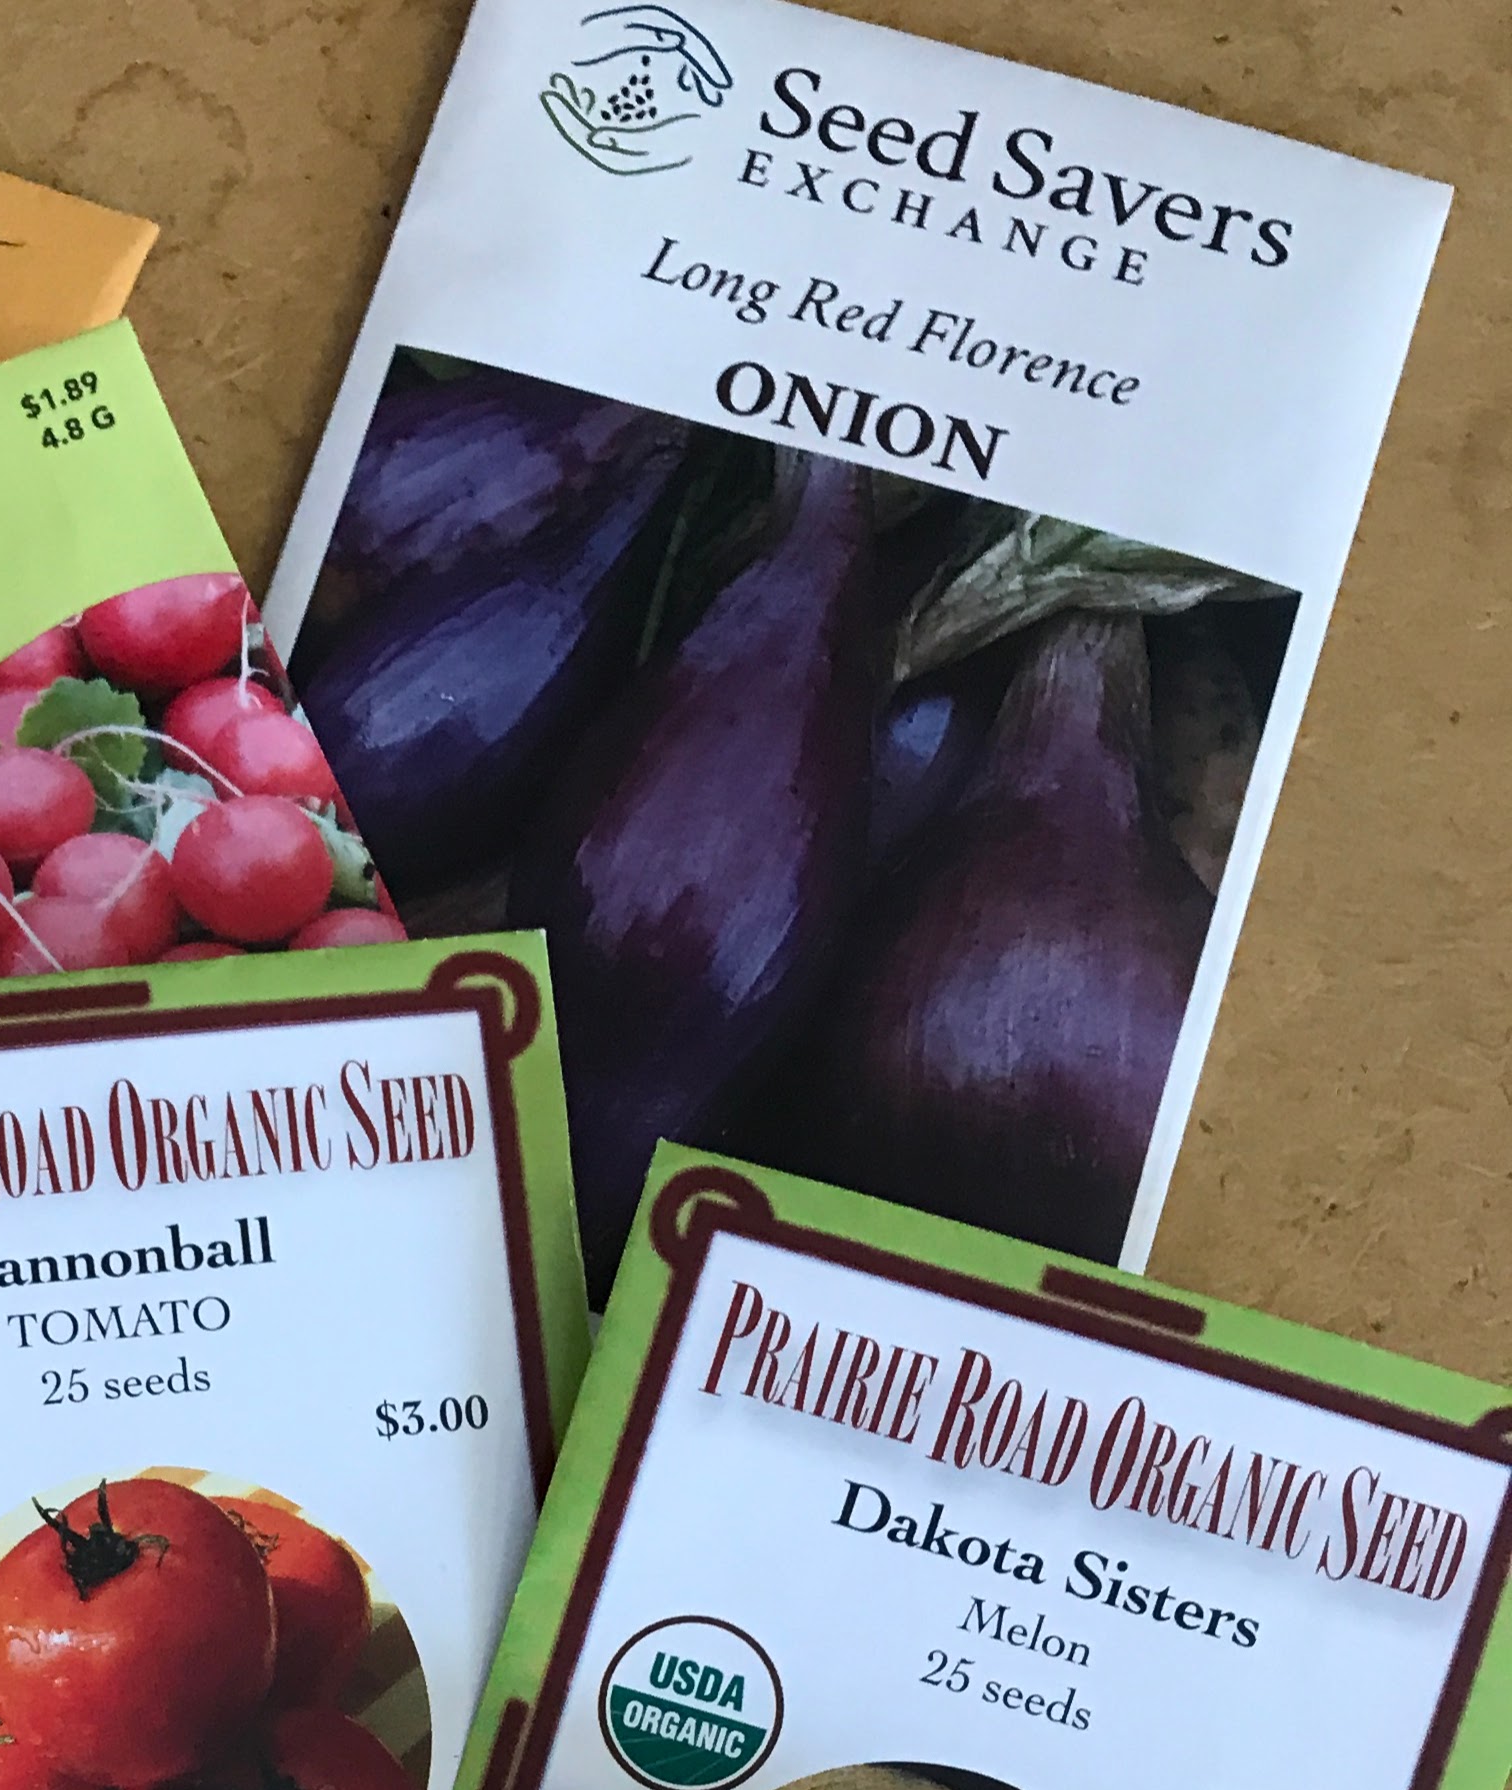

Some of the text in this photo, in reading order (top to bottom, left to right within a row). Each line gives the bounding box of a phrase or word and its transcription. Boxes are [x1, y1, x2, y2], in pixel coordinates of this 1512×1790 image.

[759, 67, 1292, 269] Seed Savers
[737, 149, 1152, 287] EXCHANGE
[642, 236, 1141, 407] Long Red Florence
[20, 371, 101, 421] $1.89
[41, 404, 116, 452] 4.8 G
[715, 360, 1010, 481] ONION
[109, 1078, 333, 1192] ORGANIC
[338, 1059, 475, 1170] SEED
[8, 1296, 232, 1349] TOMATO
[40, 1358, 211, 1405] 25 seeds
[375, 1395, 489, 1441] $3.00
[699, 1280, 1469, 1602] PRAIRIE ROAD ORGANIC SEED
[832, 1480, 1260, 1649] Dakota Sisters
[959, 1596, 1092, 1668] Melon
[650, 1652, 746, 1712] USDA
[919, 1649, 1093, 1733] 25 seeds
[623, 1699, 747, 1761] ORGANIC
